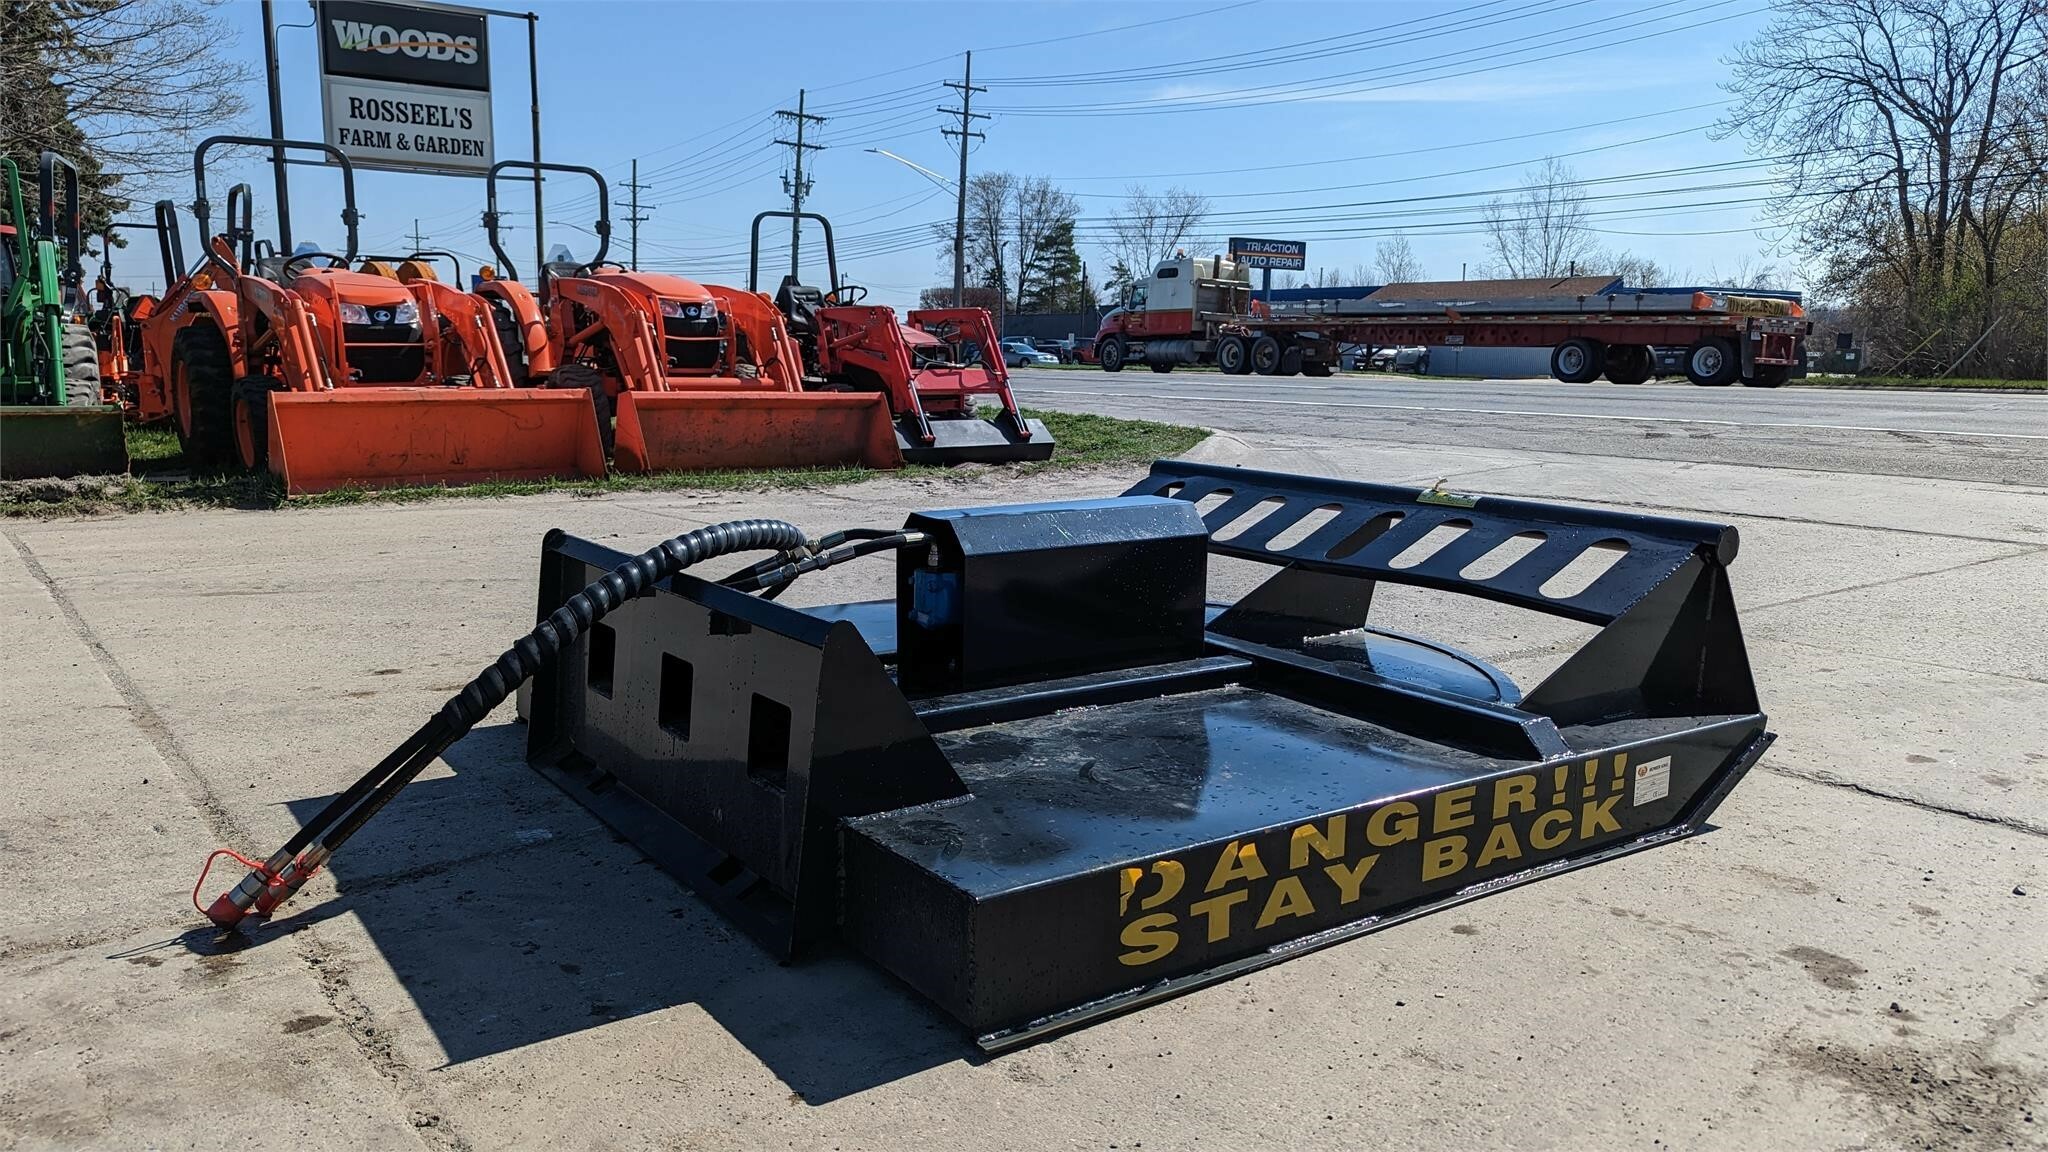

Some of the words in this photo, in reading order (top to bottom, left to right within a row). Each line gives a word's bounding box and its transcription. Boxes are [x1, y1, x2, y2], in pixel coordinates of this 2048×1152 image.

[332, 19, 478, 64] WOODS
[349, 96, 473, 130] ROSSEEL'S
[338, 127, 392, 149] FARM
[396, 133, 410, 150] &
[414, 134, 484, 157] GARDEN
[1240, 255, 1267, 266] AUTO
[1269, 257, 1302, 267] REPAIR
[1120, 753, 1627, 916] DANGER!!!
[1118, 854, 1380, 966] STAY
[1422, 794, 1624, 882] BACK
